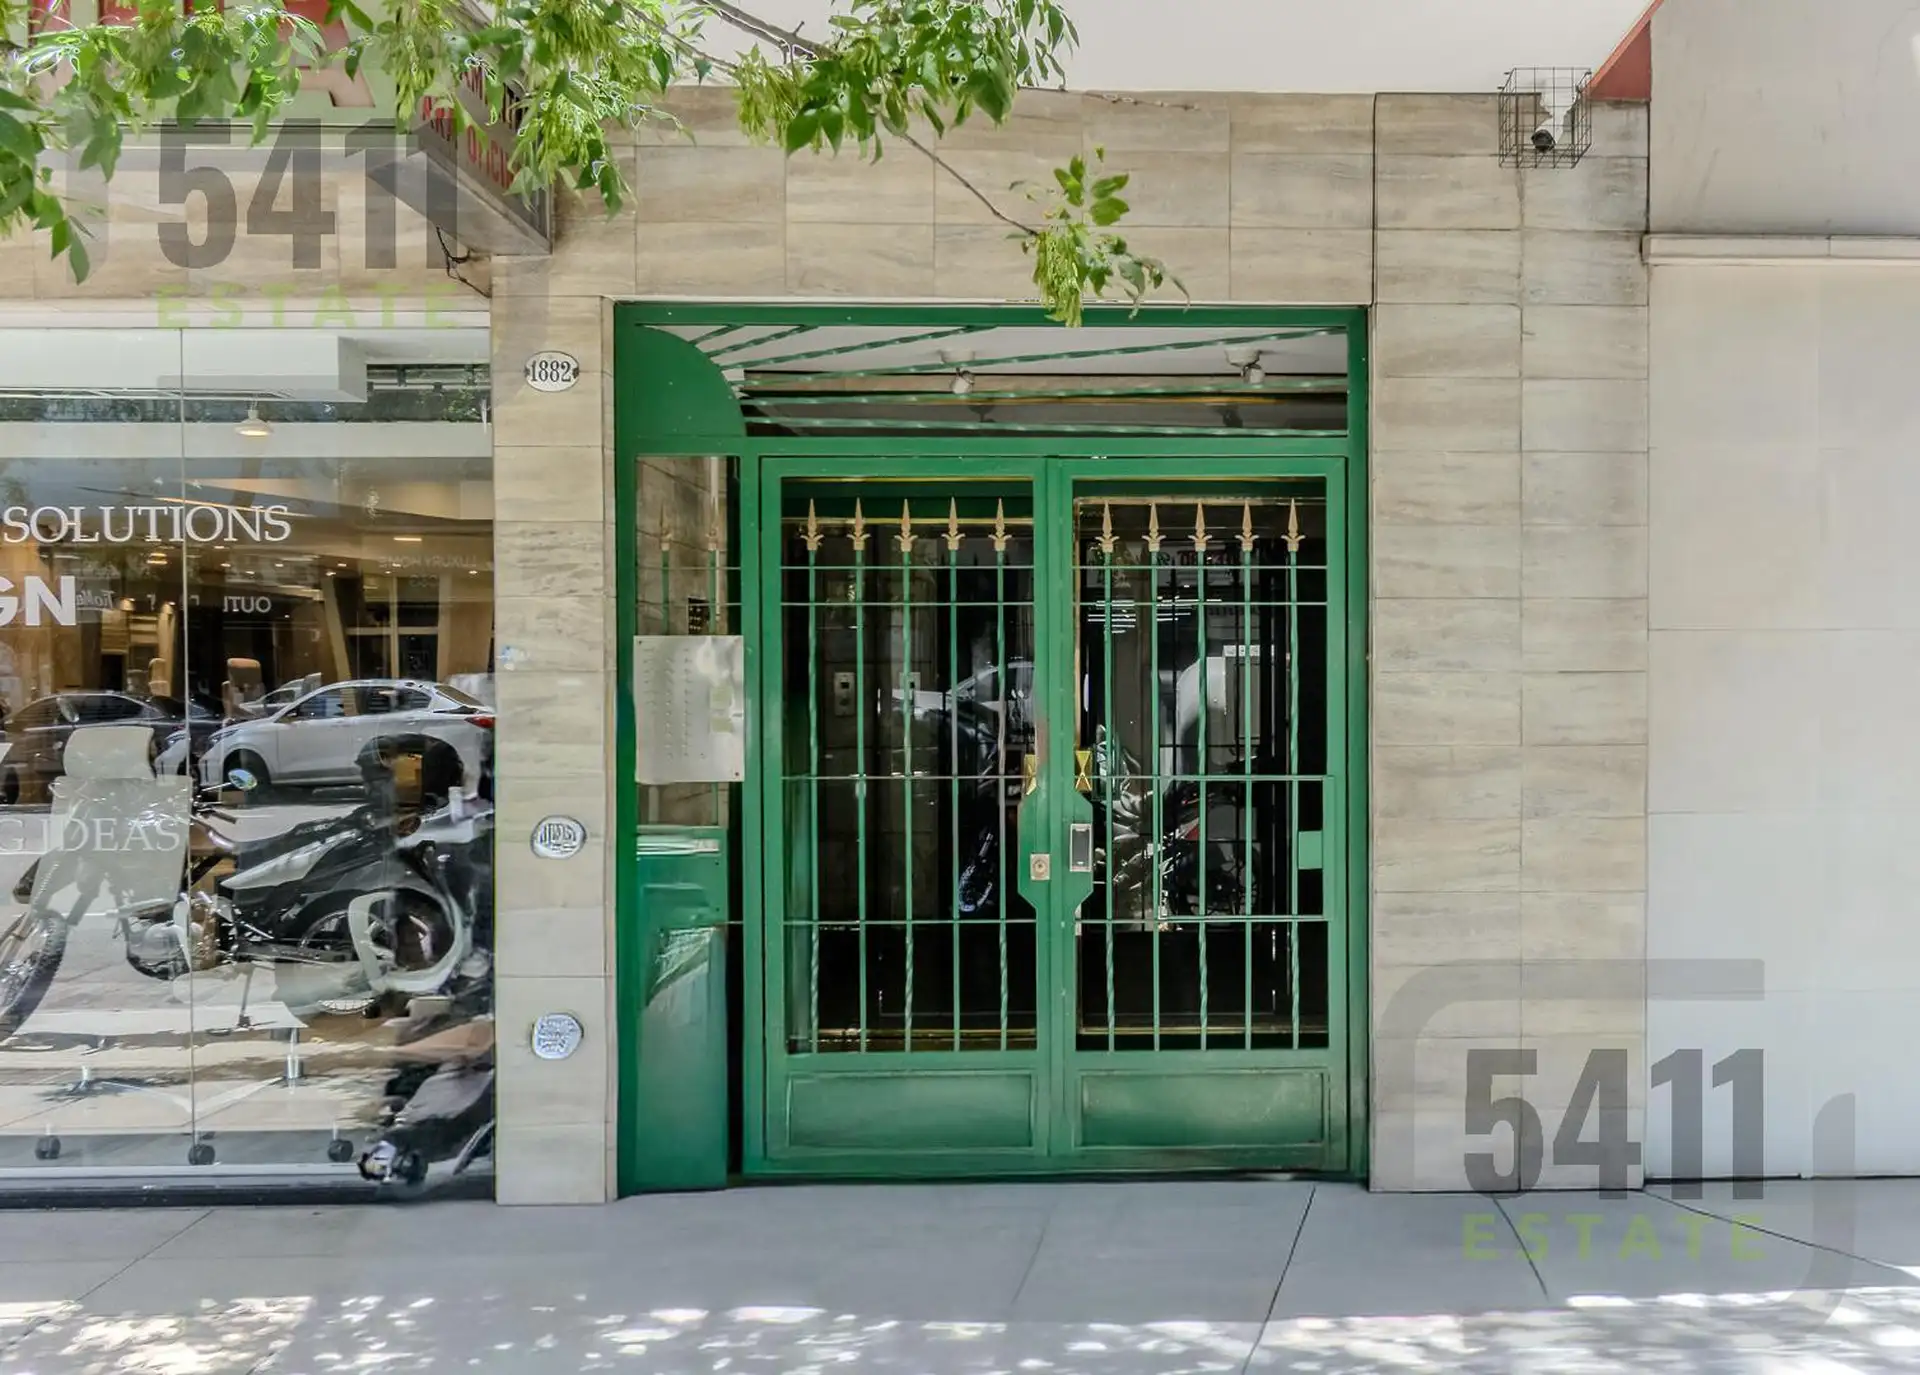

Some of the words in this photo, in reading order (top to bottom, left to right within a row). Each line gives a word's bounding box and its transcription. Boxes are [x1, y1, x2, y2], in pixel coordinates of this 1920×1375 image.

[530, 360, 572, 382] 1882
[2, 505, 292, 543] SOLUTIONS
[40, 817, 181, 851] IDEAS
